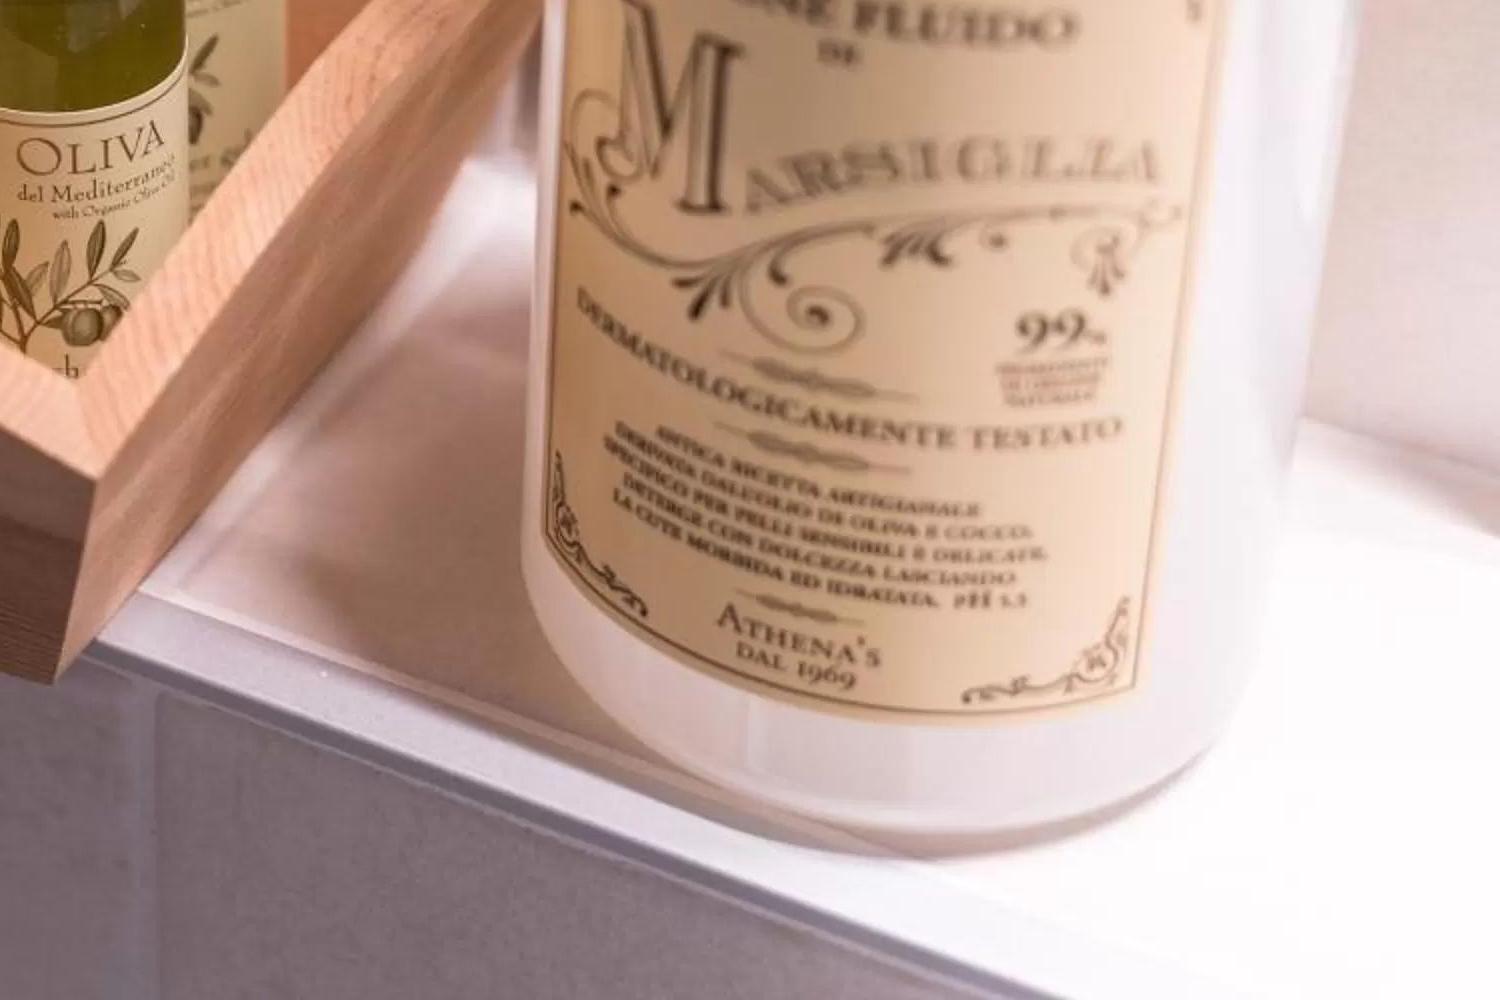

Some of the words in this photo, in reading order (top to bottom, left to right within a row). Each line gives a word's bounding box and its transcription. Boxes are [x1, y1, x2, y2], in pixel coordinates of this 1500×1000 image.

[16, 119, 165, 177] OLIVA
[16, 183, 44, 202] del
[51, 152, 176, 204] Mediterraneo
[52, 205, 79, 220] with
[82, 198, 131, 218] Organic
[577, 286, 958, 449] DERMATOLOGICAMENTE
[968, 415, 1124, 452] TESTATO
[613, 487, 633, 512] LA
[707, 518, 752, 545] CON
[735, 640, 788, 671] DAL
[797, 660, 857, 692] 1969
